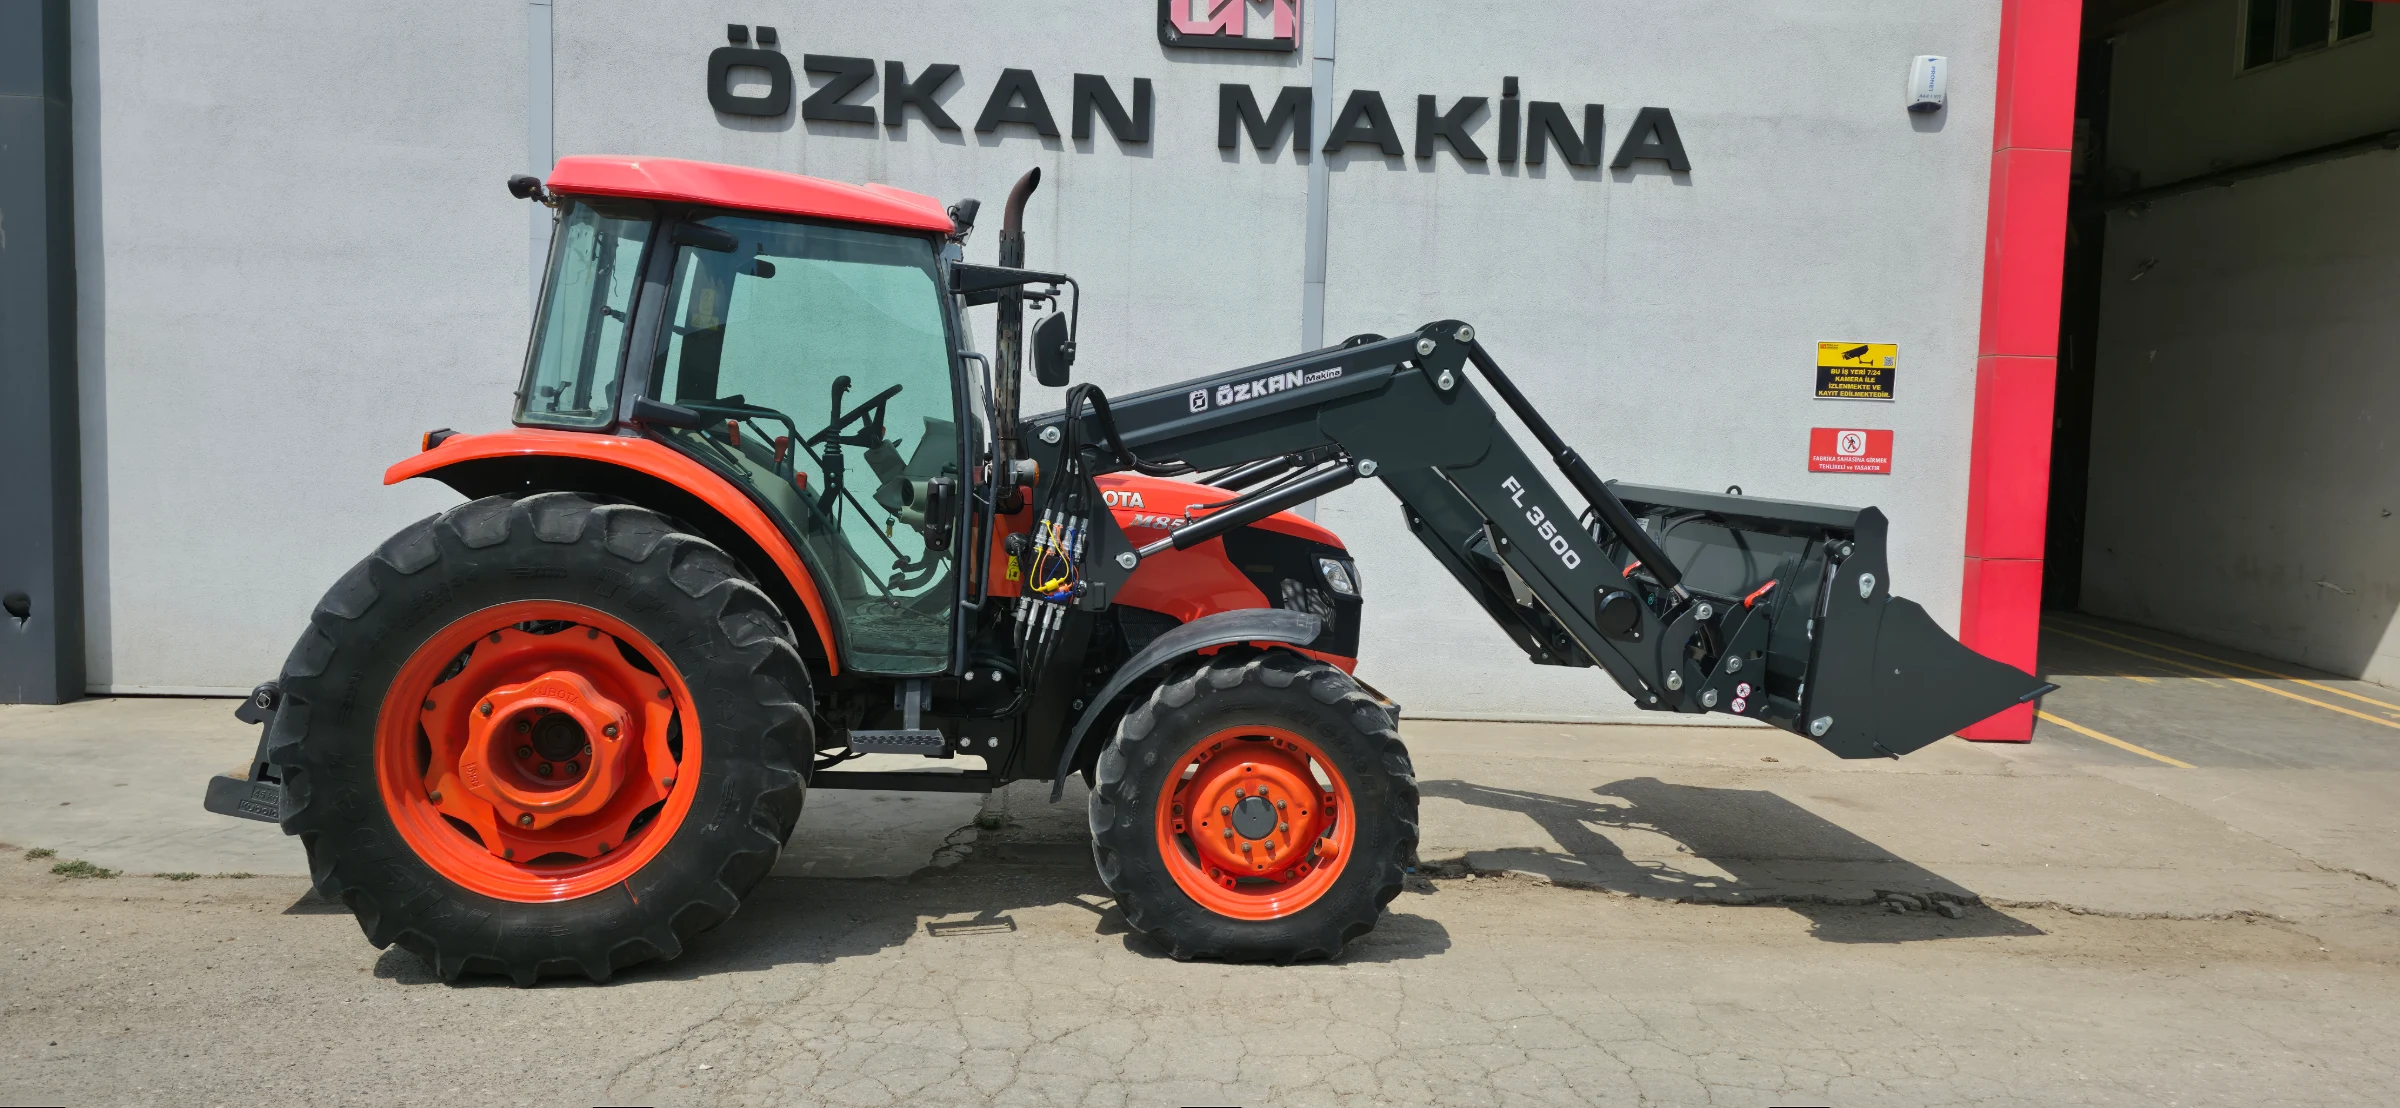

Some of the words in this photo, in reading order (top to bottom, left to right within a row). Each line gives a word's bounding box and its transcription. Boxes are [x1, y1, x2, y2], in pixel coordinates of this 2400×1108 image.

[707, 24, 1152, 142] ÖZKAN
[1217, 76, 1692, 171] MAKİNA
[1841, 368, 1849, 376] İŞ
[1216, 369, 1303, 406] ÖZKAN
[1305, 368, 1341, 384] Makina
[1840, 390, 1891, 398] EDİLMEKTEDİR.
[1501, 475, 1525, 509] FL
[1525, 505, 1581, 570] 3500
[530, 685, 579, 706] KUBOTA
[253, 788, 266, 800] 45
[266, 791, 279, 805] kg
[240, 800, 279, 819] Kubota
